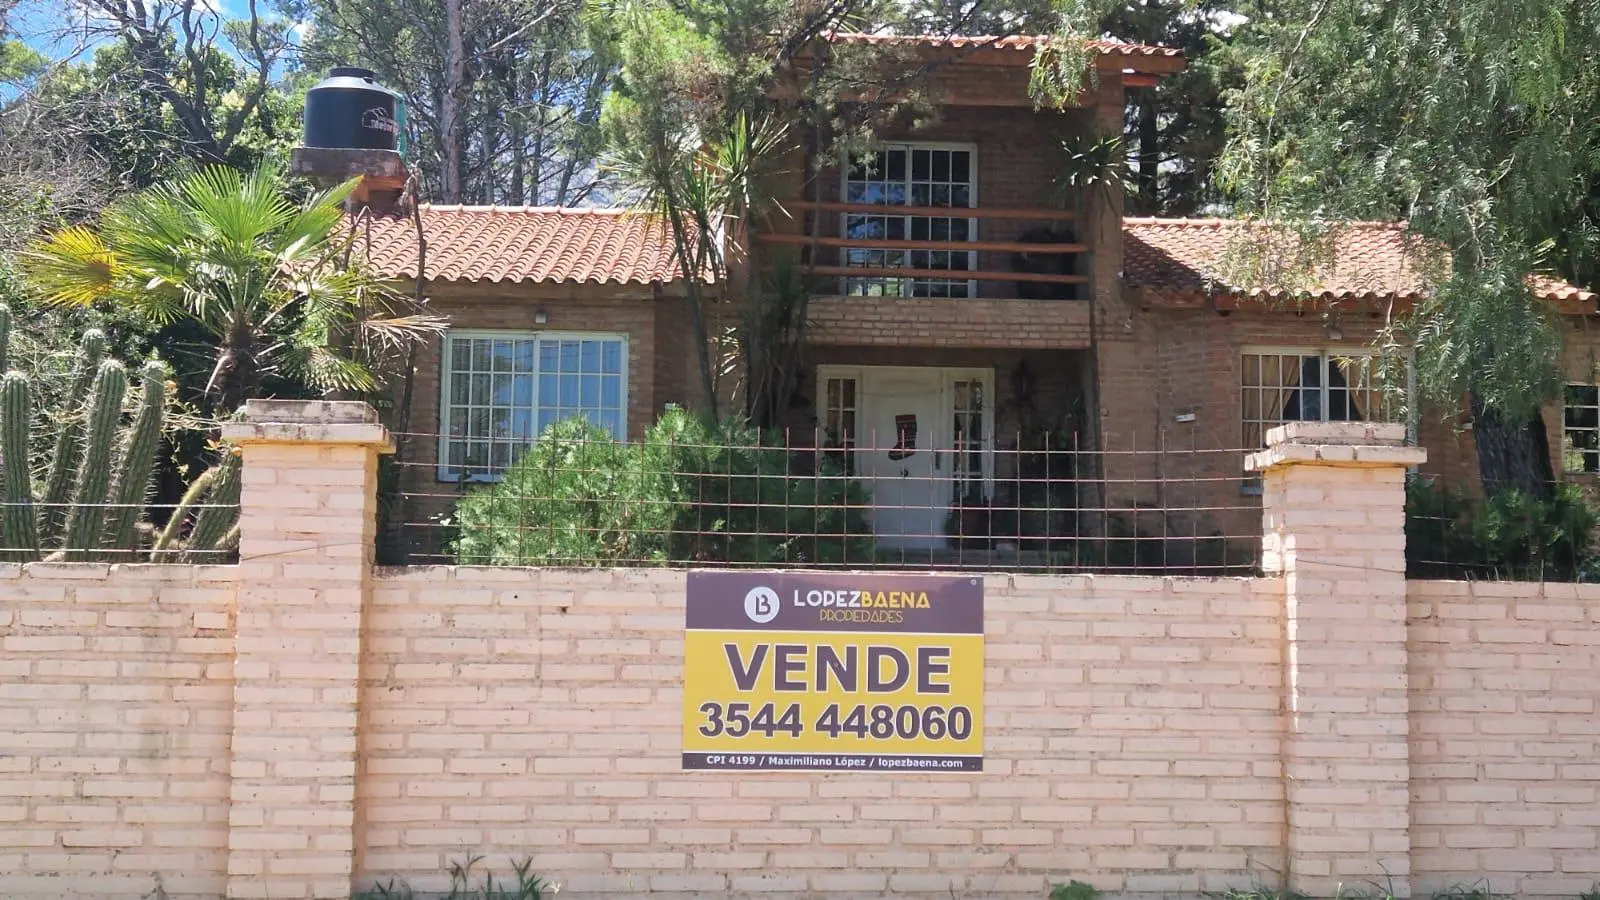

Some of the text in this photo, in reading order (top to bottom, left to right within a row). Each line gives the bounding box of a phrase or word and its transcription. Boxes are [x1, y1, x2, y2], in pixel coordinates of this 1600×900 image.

[724, 644, 951, 693] VENDE
[699, 702, 972, 740] 3544 448060
[706, 756, 725, 765] CPI
[728, 756, 756, 765] 4199
[768, 756, 832, 766] Maximiliano
[835, 757, 866, 768] López
[878, 758, 963, 768] lopezbaena.com
